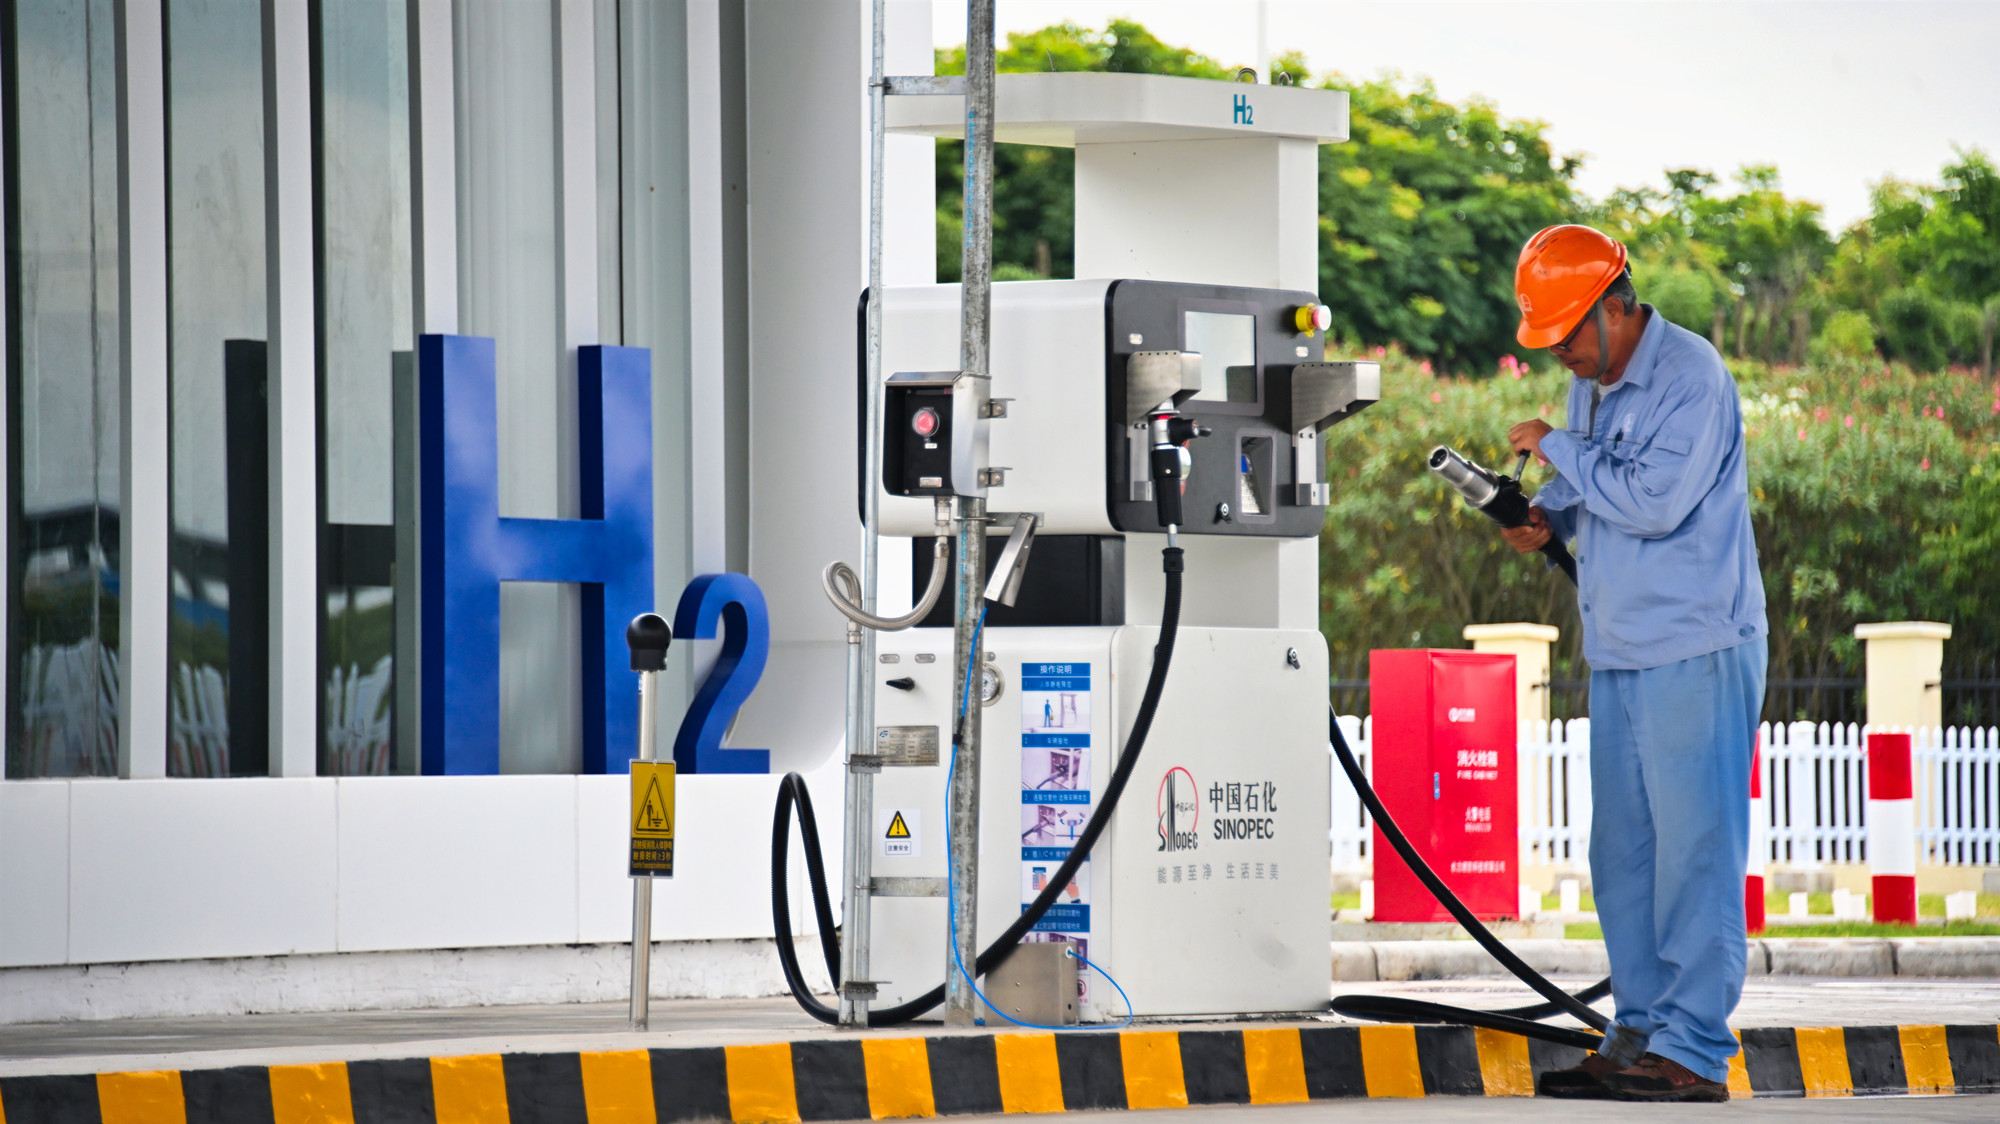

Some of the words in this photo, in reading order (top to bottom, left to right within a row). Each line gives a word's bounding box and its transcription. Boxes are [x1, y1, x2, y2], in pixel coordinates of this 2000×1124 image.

[1233, 94, 1254, 125] H2
[419, 333, 770, 775] H2
[1040, 664, 1072, 675] 操作说明
[1457, 750, 1498, 767] 消火栓箱
[1208, 781, 1278, 813] 中国石化
[1213, 818, 1275, 840] SINOPEC
